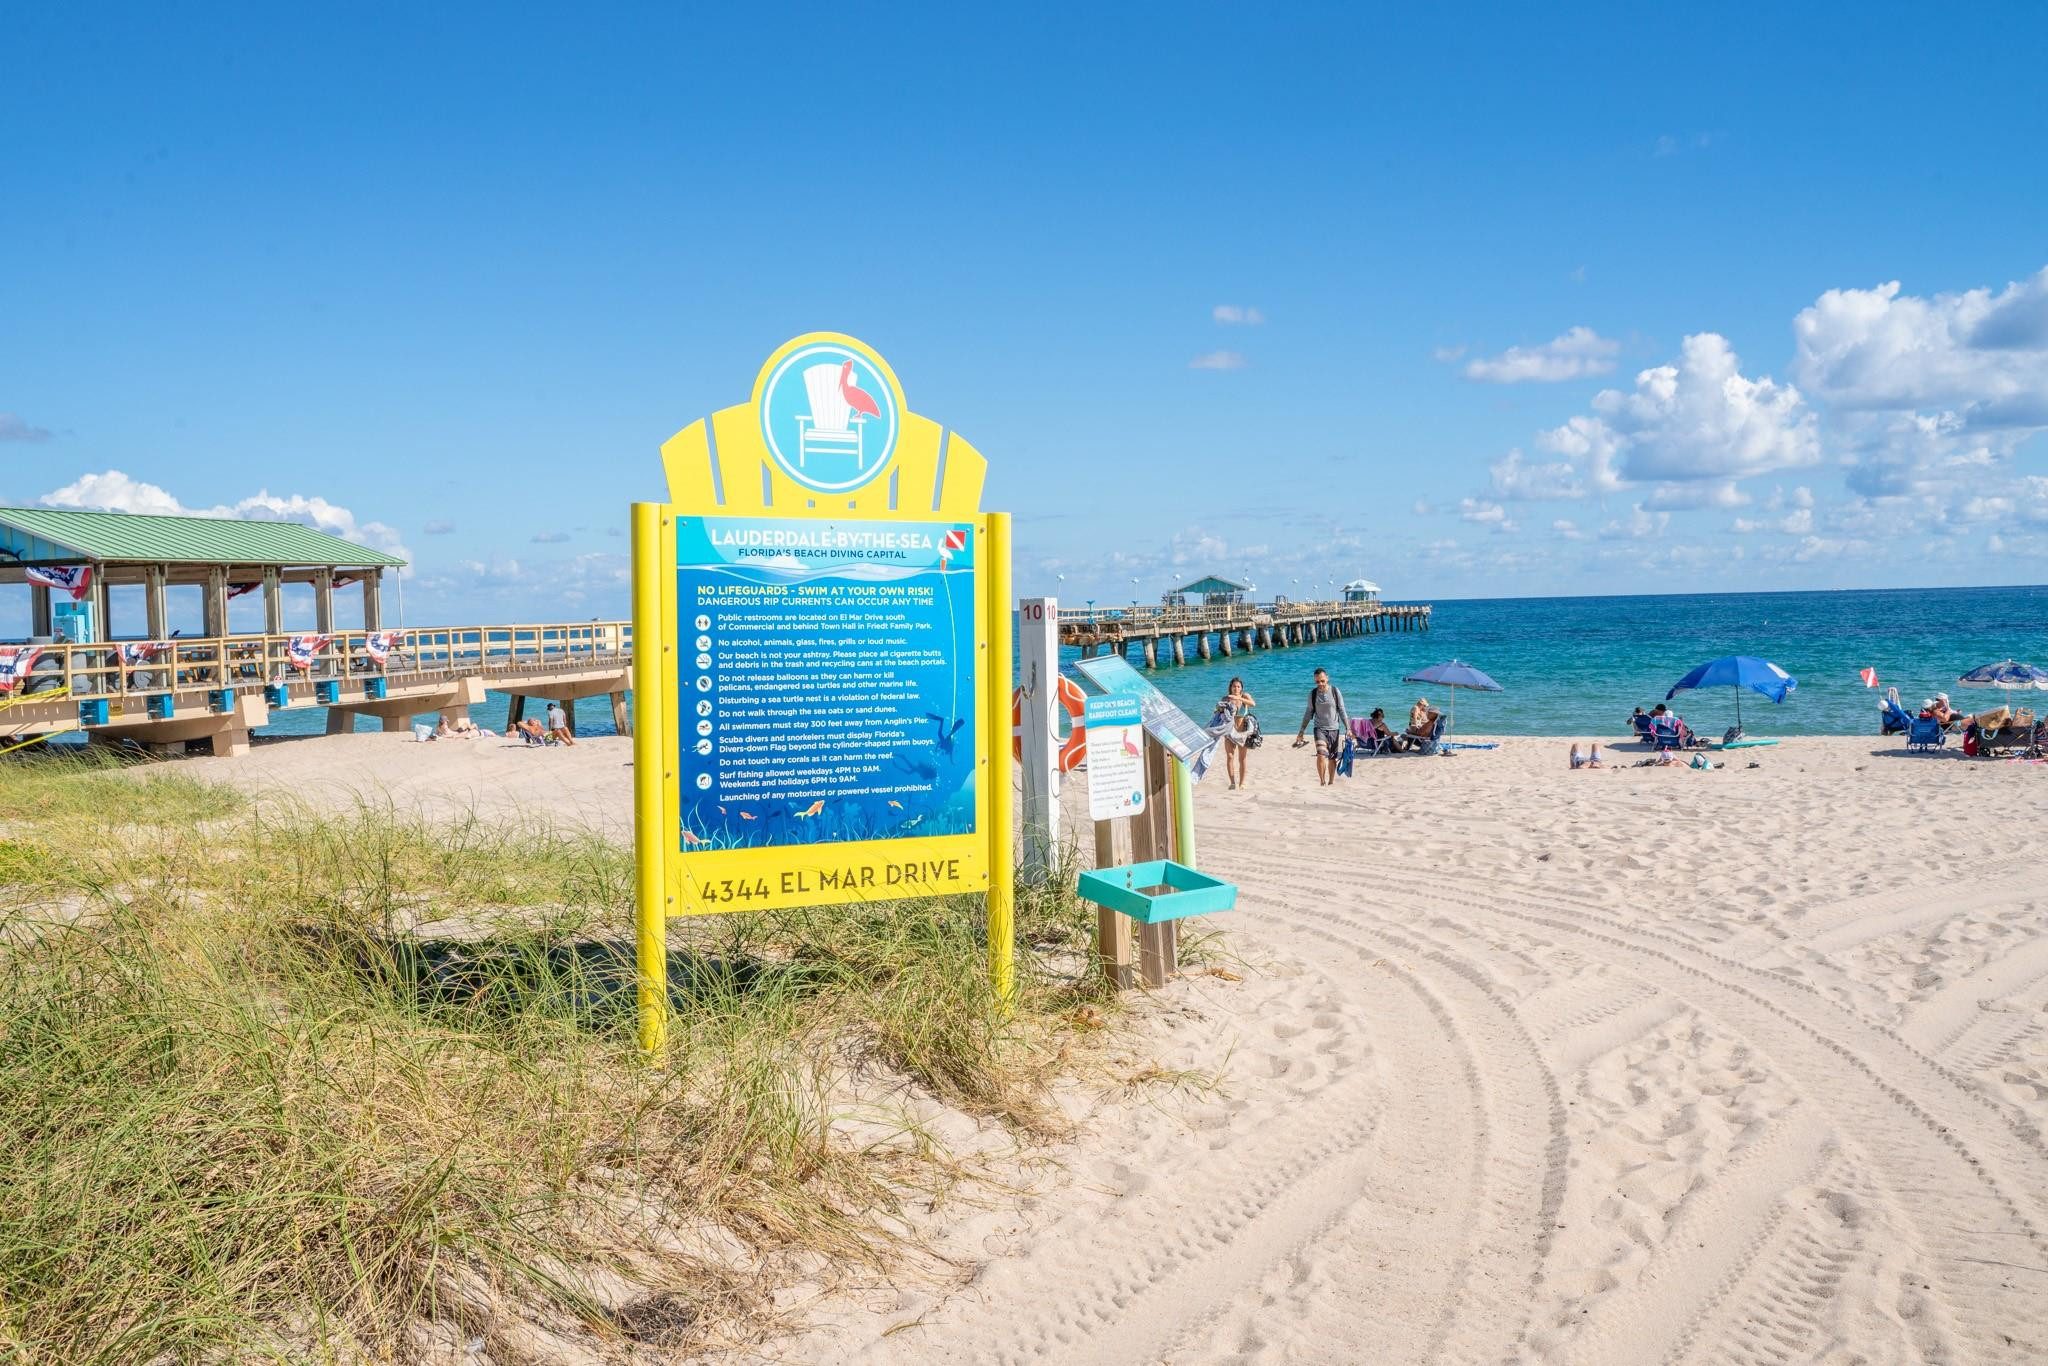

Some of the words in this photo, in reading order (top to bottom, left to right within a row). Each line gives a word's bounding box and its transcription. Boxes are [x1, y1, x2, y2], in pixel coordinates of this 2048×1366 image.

[738, 548, 792, 557] FLORIDA'S
[794, 549, 828, 558] BEACH
[830, 549, 864, 558] DIVING
[866, 550, 907, 559] CAPITAL
[697, 585, 715, 596] NO
[718, 586, 789, 596] LIFEGUARDS
[797, 586, 828, 596] SWIM
[830, 586, 845, 596] AT
[846, 586, 877, 596] YOUR
[878, 586, 905, 596] OWN
[907, 586, 934, 596] RISK!
[697, 597, 761, 606] DANGEROUS
[763, 597, 780, 606] RIP
[781, 597, 833, 606] CURRENTS
[834, 597, 855, 606] CAN
[856, 597, 890, 606] OCCUR
[891, 597, 913, 606] ANY
[913, 597, 934, 606] TIME
[1023, 604, 1042, 620] 10
[1047, 604, 1056, 620] 10
[890, 622, 913, 630] Family
[838, 638, 856, 646] grills
[890, 650, 921, 658] cigarette
[822, 660, 855, 668] recycling
[767, 708, 798, 717] through
[1088, 710, 1117, 719] BAREFOOT
[731, 722, 771, 730] swimmers
[793, 721, 809, 729] stay
[884, 718, 912, 726] Anglin's
[719, 736, 743, 744] Scuba
[745, 735, 768, 743] divers
[770, 734, 785, 742] and
[719, 744, 768, 753] Divers-down
[788, 742, 817, 751] beyond
[832, 739, 890, 750] cylinder-shaped
[719, 771, 736, 779] Surf
[737, 770, 763, 778] fishing
[765, 769, 795, 777] allowed
[797, 768, 833, 776] weekdays
[719, 780, 760, 788] Weekends
[761, 779, 776, 787] and
[778, 778, 809, 786] holidays
[811, 776, 828, 784] 6PM
[719, 793, 760, 801] Launching
[772, 792, 786, 800] any
[787, 789, 826, 797] motorized
[837, 787, 869, 796] powered
[702, 878, 770, 903] 4344
[780, 871, 810, 894] EL
[819, 866, 875, 891] MAR
[886, 859, 960, 885] DRIVE
